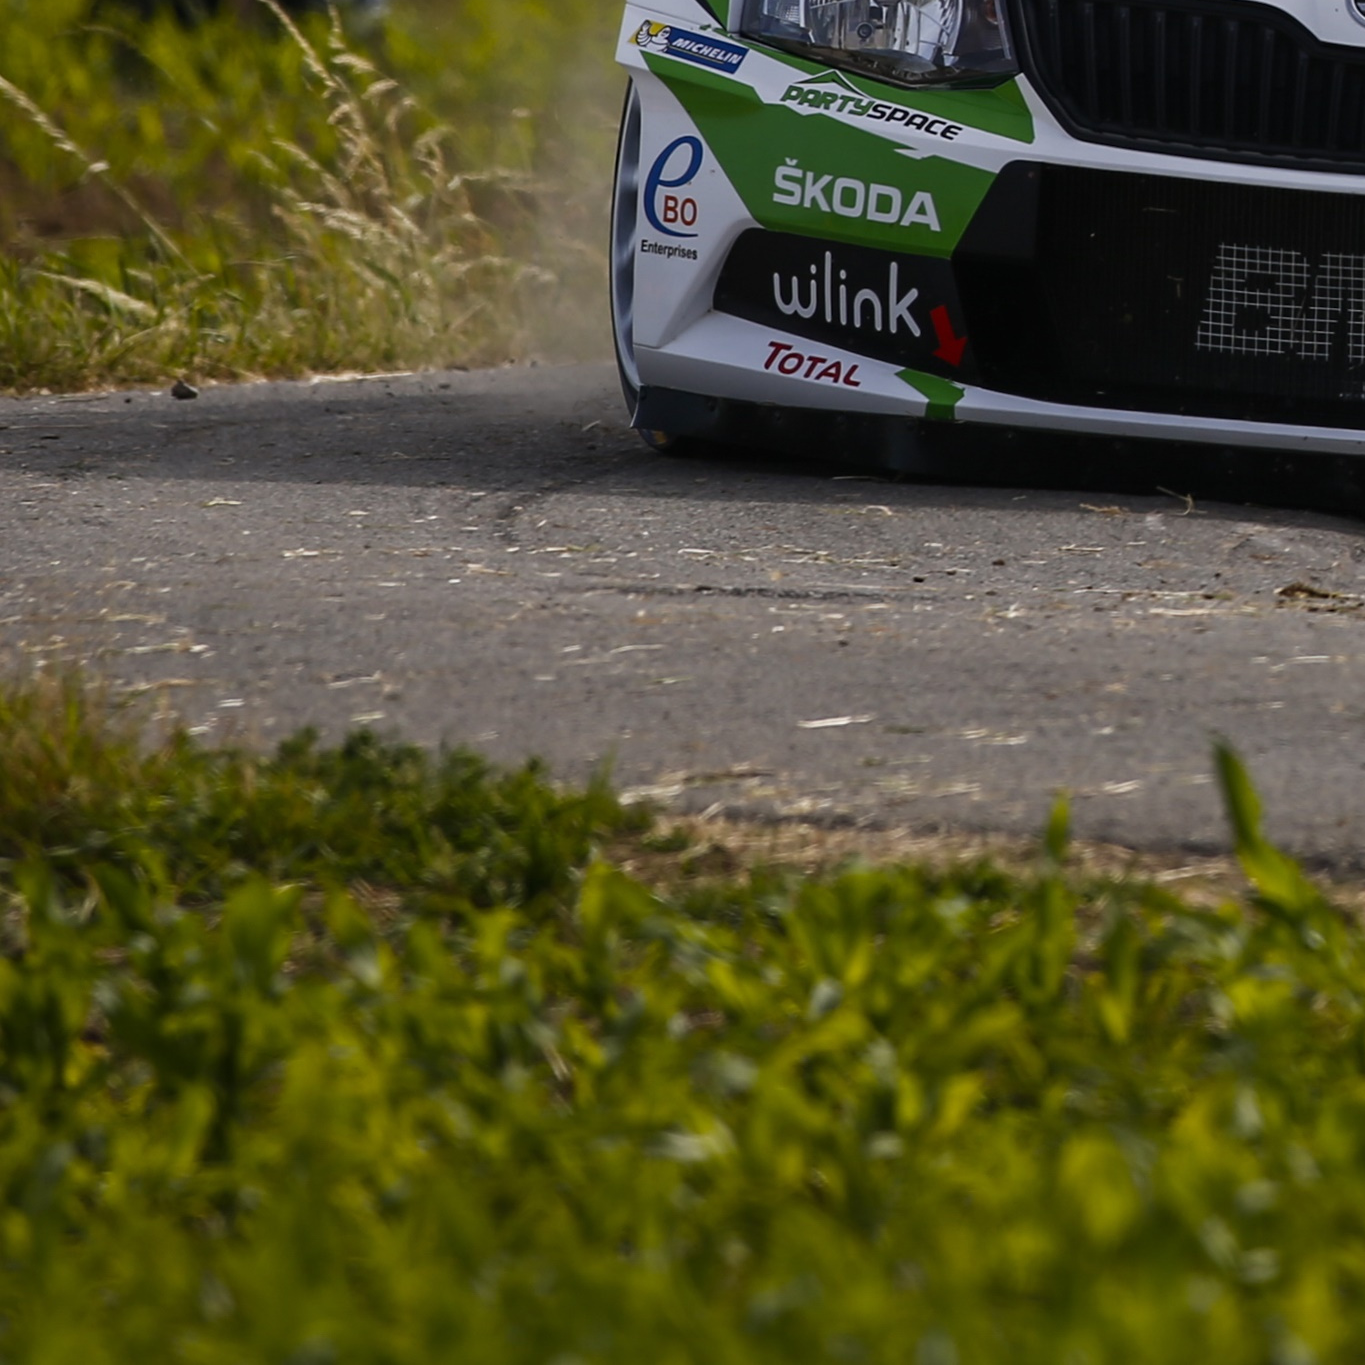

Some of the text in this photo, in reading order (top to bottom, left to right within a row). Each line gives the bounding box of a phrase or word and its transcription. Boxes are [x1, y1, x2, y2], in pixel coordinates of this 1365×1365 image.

[672, 37, 742, 65] MICHELIN
[663, 195, 698, 227] BO
[772, 158, 941, 232] ŠKODA
[640, 240, 698, 261] Enterprises
[763, 342, 861, 387] TOTAL
